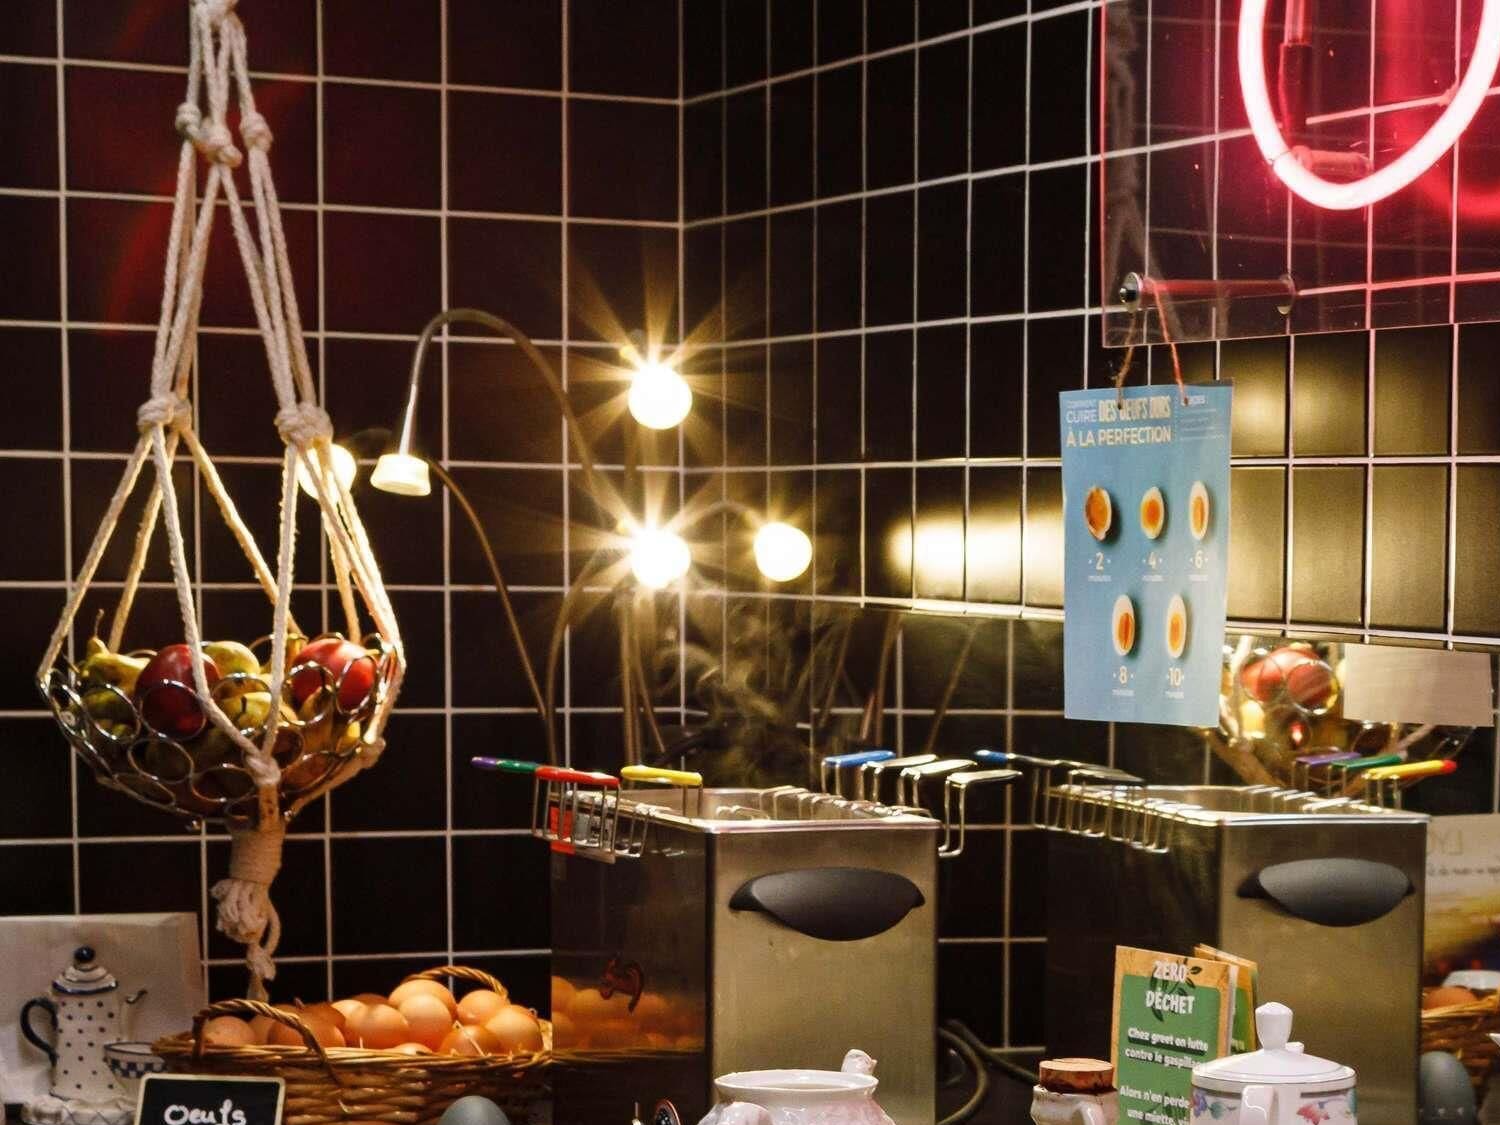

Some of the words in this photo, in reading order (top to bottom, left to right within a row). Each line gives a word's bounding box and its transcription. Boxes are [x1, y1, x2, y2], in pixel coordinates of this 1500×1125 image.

[1079, 432, 1096, 447] LA
[1099, 426, 1172, 446] PERFECTION
[1096, 551, 1104, 570] 2
[1148, 552, 1157, 569] 4
[1195, 550, 1203, 569] 6
[1119, 665, 1128, 684] 8
[1168, 667, 1181, 687] 10
[1145, 987, 1196, 1014] DÉCHET
[1127, 1027, 1150, 1041] Chez
[1175, 1037, 1186, 1047] en
[1187, 1036, 1209, 1052] lutte
[1124, 1047, 1153, 1061] contre
[1154, 1051, 1163, 1063] le
[1120, 1085, 1142, 1100] Alors
[1143, 1089, 1162, 1103] n'en
[1163, 1094, 1190, 1108] perde
[1127, 1109, 1144, 1119] une
